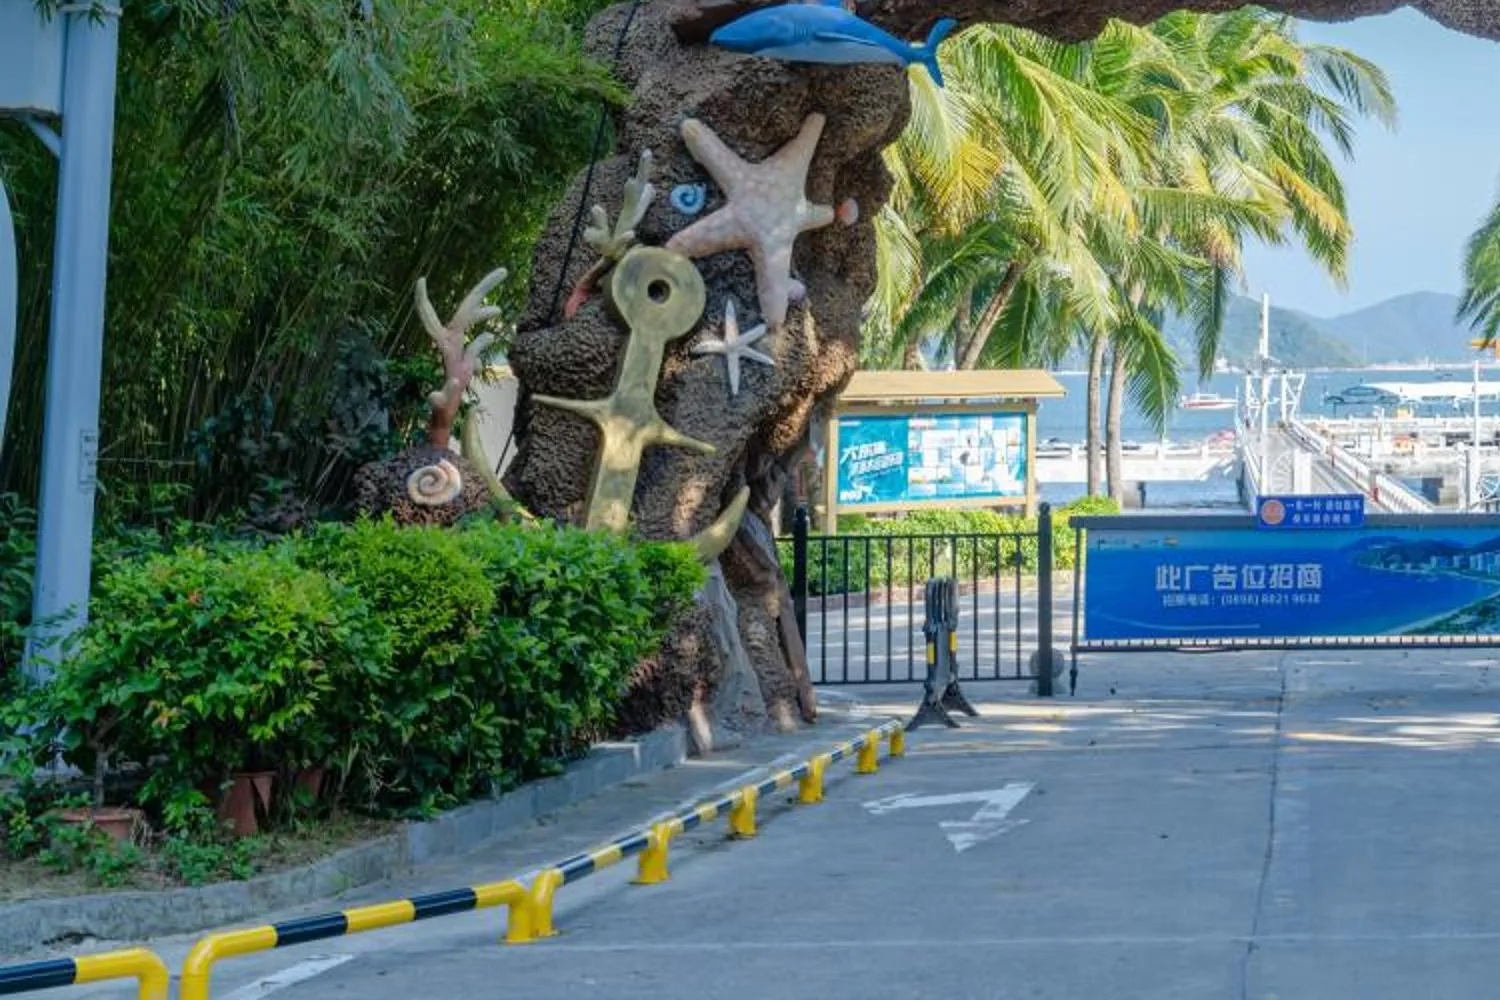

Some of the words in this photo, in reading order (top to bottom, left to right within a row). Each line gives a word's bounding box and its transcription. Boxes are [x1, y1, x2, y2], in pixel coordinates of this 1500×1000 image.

[1155, 564, 1323, 591] 此广告位招商
